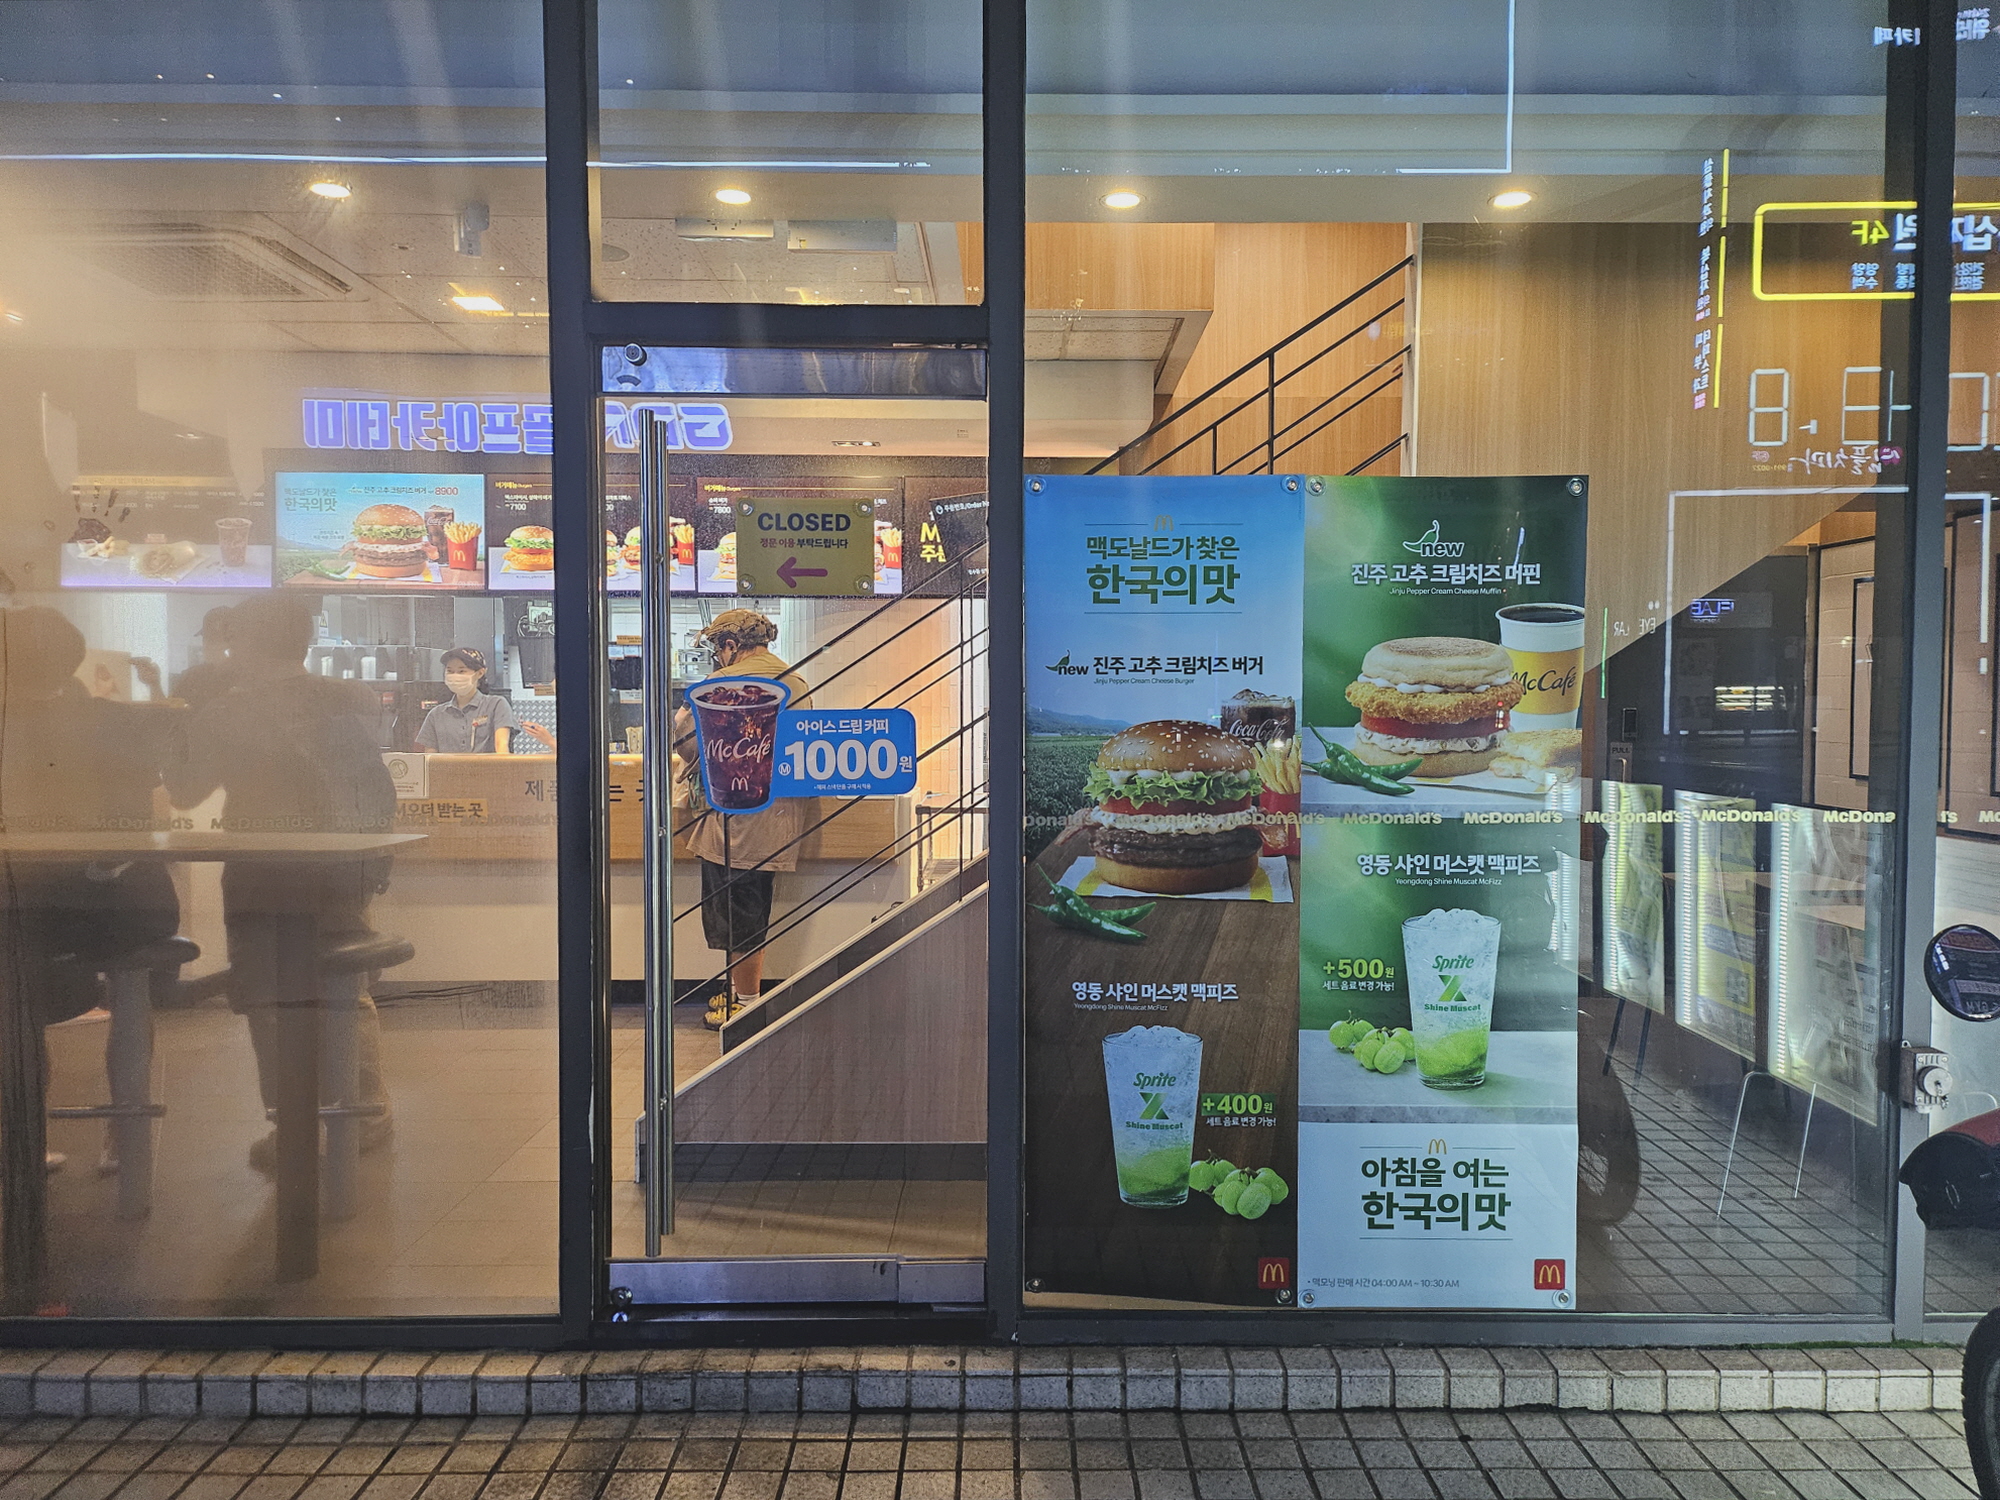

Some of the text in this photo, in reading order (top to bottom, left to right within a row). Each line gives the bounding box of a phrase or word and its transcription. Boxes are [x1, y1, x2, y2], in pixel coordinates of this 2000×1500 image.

[434, 486, 459, 496] 8900
[509, 503, 527, 511] 7100
[757, 512, 852, 532] CLOSED
[760, 538, 849, 549] 정문 이용 부탁드립니다
[1086, 536, 1240, 560] 맥도날드가 찾은
[1421, 542, 1465, 557] new
[1351, 563, 1541, 585] 진주 고추 크림치즈 머핀
[1389, 588, 1406, 596] Jinju
[1406, 588, 1430, 596] Pepper
[1058, 656, 1264, 676] new 진주 고추 크림치즈 버거
[1093, 678, 1108, 686] Jinju
[1108, 678, 1130, 686] Pepper
[1175, 678, 1195, 686] Burger
[796, 718, 889, 736] 아이스 드립 커피
[707, 733, 772, 763] McCafé
[437, 801, 467, 818] 받는
[467, 801, 484, 818] 곳
[1024, 813, 1098, 827] Donald's
[1343, 811, 1443, 826] McDonald's
[1462, 810, 1564, 825] McDonald's
[1584, 810, 1684, 824] McDonald's
[1701, 809, 1801, 824] McDonald's
[1356, 854, 1542, 876] 영동 샤인 머스캣 맥피즈
[1395, 878, 1433, 886] Yeongdong
[1432, 954, 1475, 972] Sprite
[1071, 981, 1239, 1003] 영동 샤인 머스캣 맥피즈
[1322, 981, 1395, 992] 세트 음료 변경 가능!
[1074, 1003, 1107, 1011] Yeongdong
[1424, 1003, 1481, 1012] Shine Muscat
[1133, 1072, 1177, 1090] Sprite
[1125, 1121, 1184, 1130] Shine Muscat
[1205, 1117, 1222, 1127] 세트
[1223, 1117, 1240, 1127] 음료
[1240, 1117, 1256, 1127] 변경
[1361, 1157, 1509, 1188] 아침을 여는
[1337, 1278, 1354, 1287] 판매
[1354, 1278, 1370, 1287] 시간
[1371, 1279, 1397, 1287] 04:00
[1398, 1279, 1412, 1287] AM
[1420, 1279, 1444, 1287] 10:30
[1444, 1279, 1459, 1288] AM
